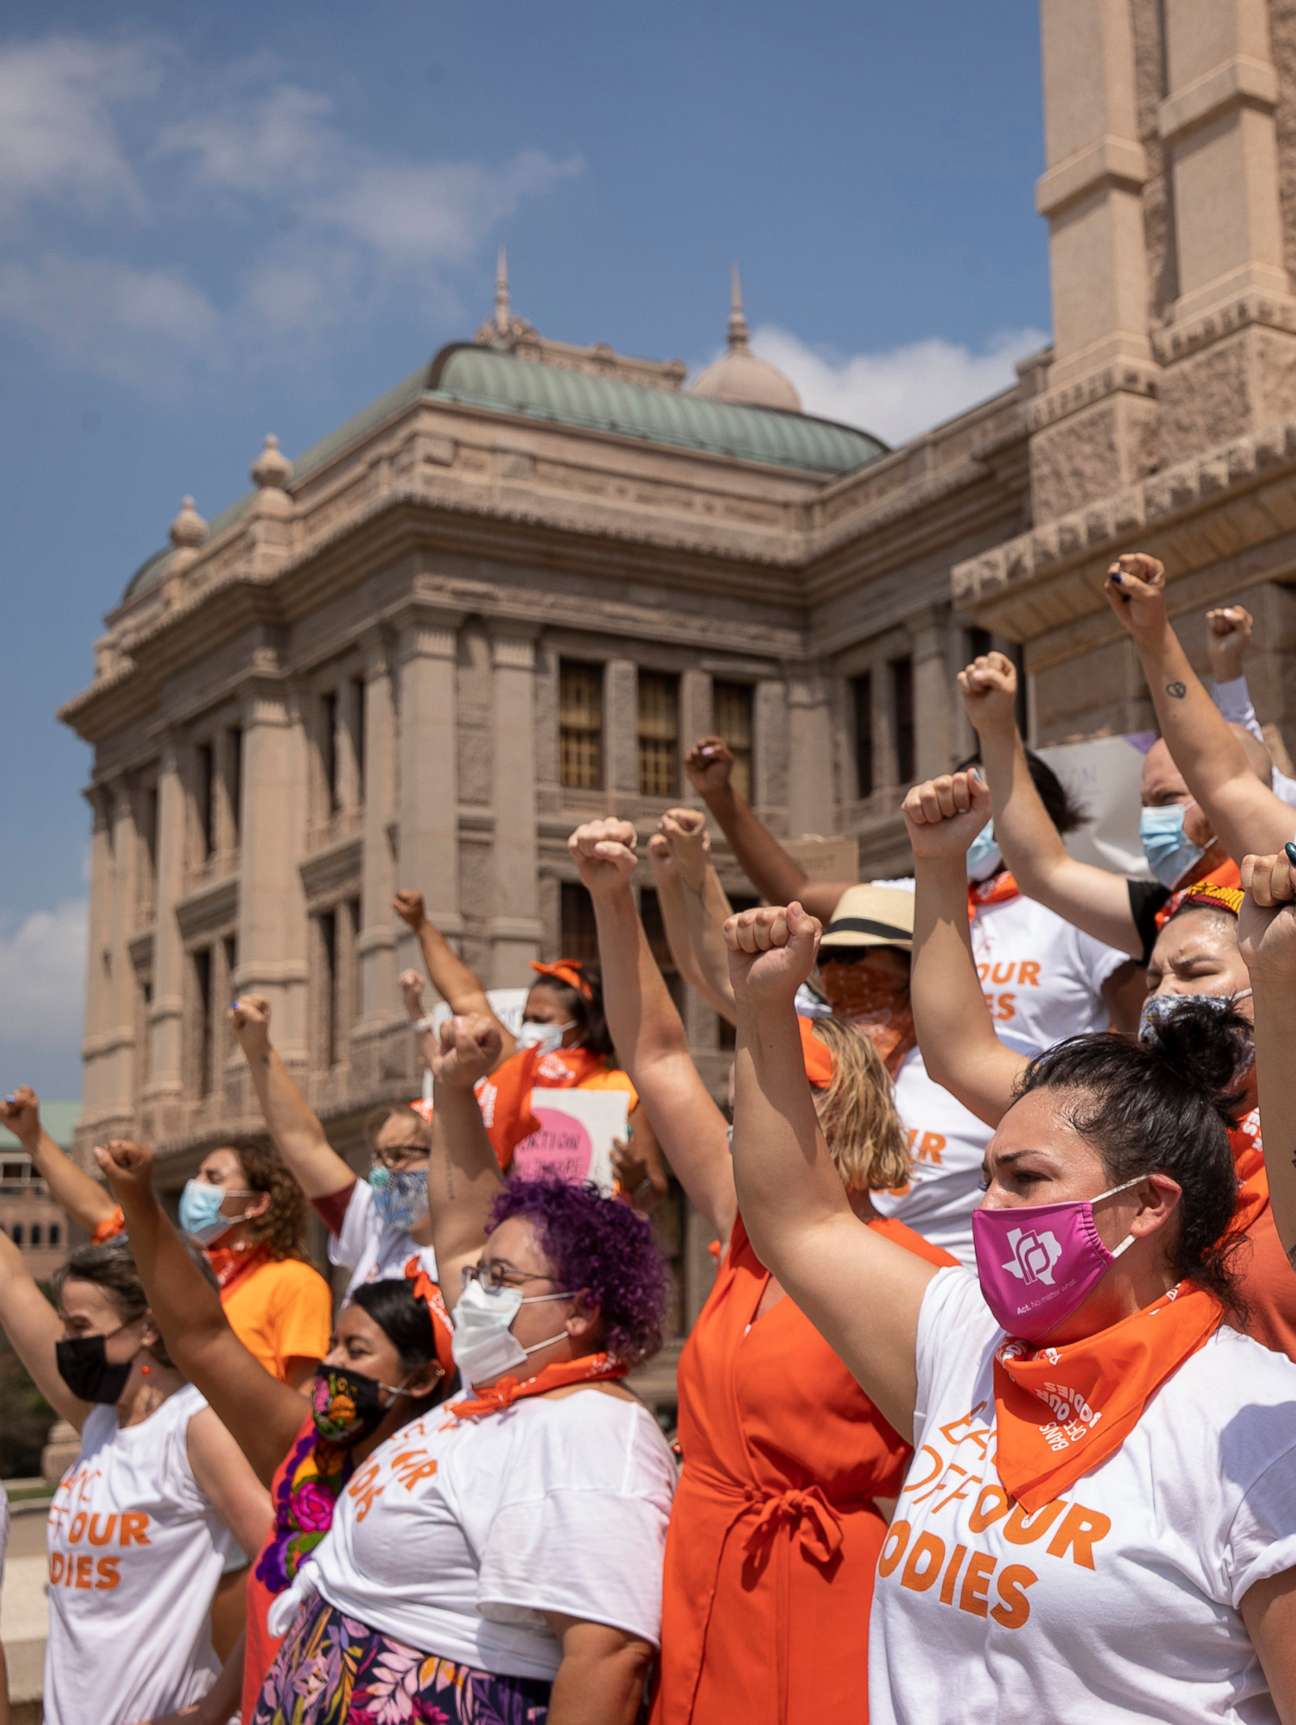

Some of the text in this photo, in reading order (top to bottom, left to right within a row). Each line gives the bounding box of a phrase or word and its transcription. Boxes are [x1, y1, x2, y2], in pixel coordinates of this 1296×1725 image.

[1034, 1388, 1070, 1421] OUR
[1039, 1421, 1070, 1451] BANS
[1063, 1418, 1087, 1442] OFF
[68, 1510, 153, 1547] OUR
[968, 1484, 1113, 1571] OUR
[49, 1551, 122, 1591] DIES
[878, 1519, 1041, 1630] ODIES
